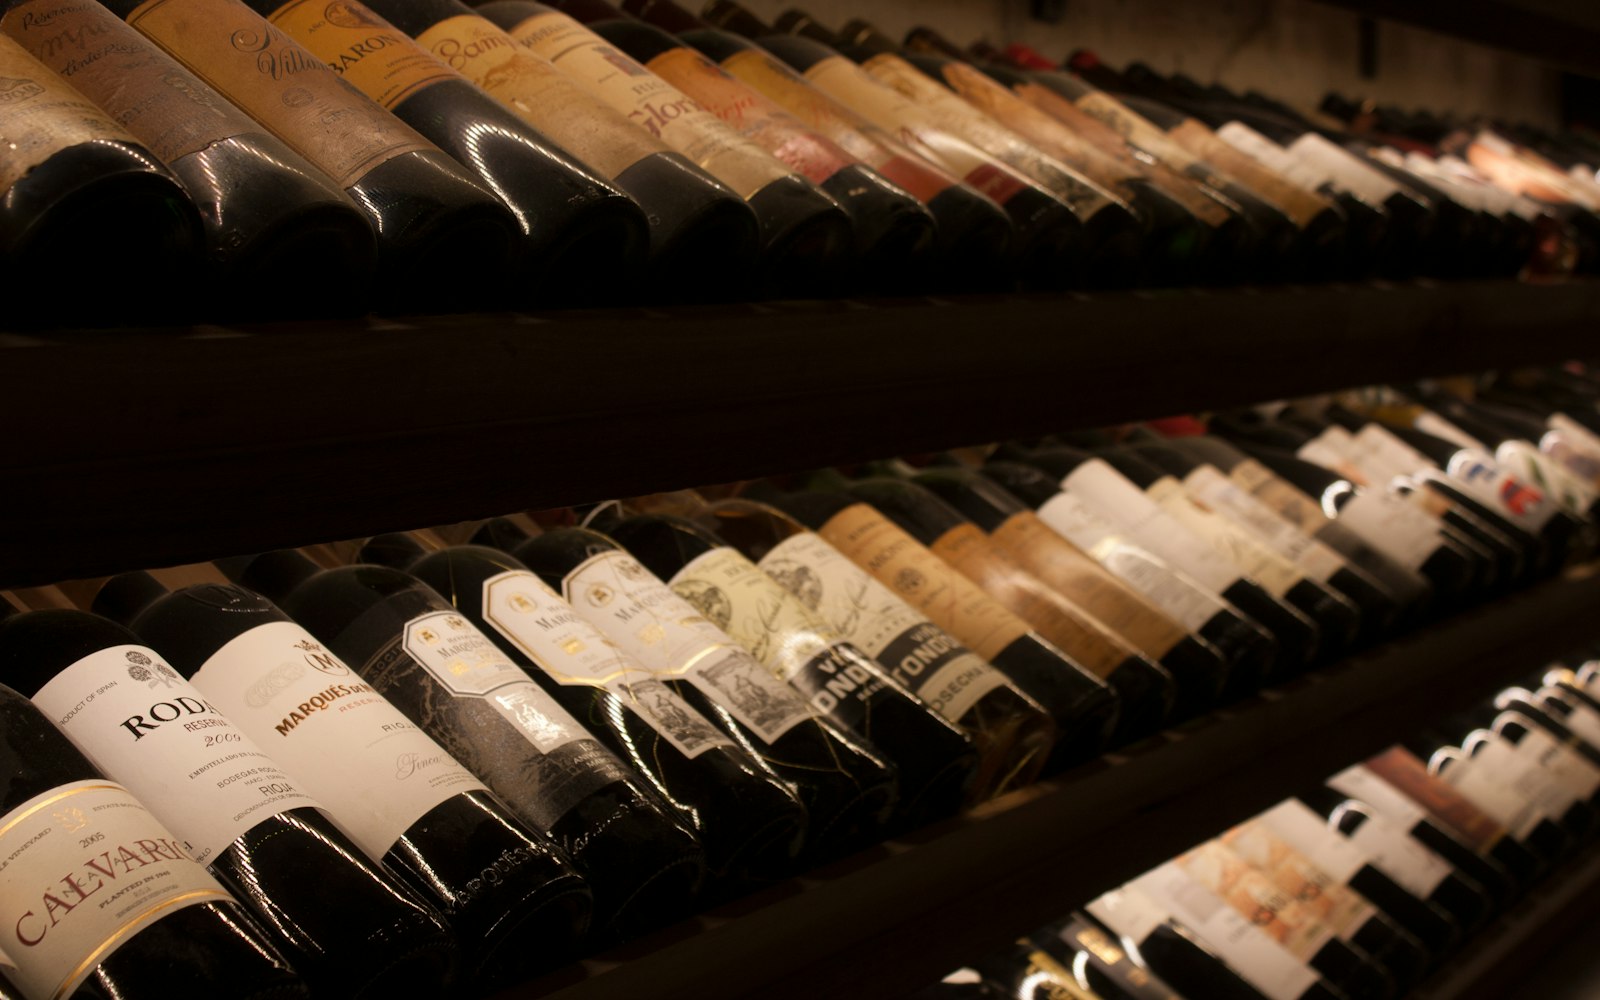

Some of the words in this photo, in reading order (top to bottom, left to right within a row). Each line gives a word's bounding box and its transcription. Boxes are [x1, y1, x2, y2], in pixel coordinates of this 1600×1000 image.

[60, 701, 87, 727] RODUCT
[96, 680, 119, 696] SPAIN
[275, 684, 351, 737] MARQUÉS
[120, 696, 224, 742] RODA
[184, 718, 229, 733] RESERVA
[204, 733, 241, 747] 2009
[188, 752, 239, 780] EMBOTELLADO
[216, 768, 258, 789] BODEGAS
[259, 782, 297, 797] RIOJA
[8, 827, 52, 861] VINEYARD
[79, 831, 105, 849] 2005
[98, 880, 143, 910] PLANTED
